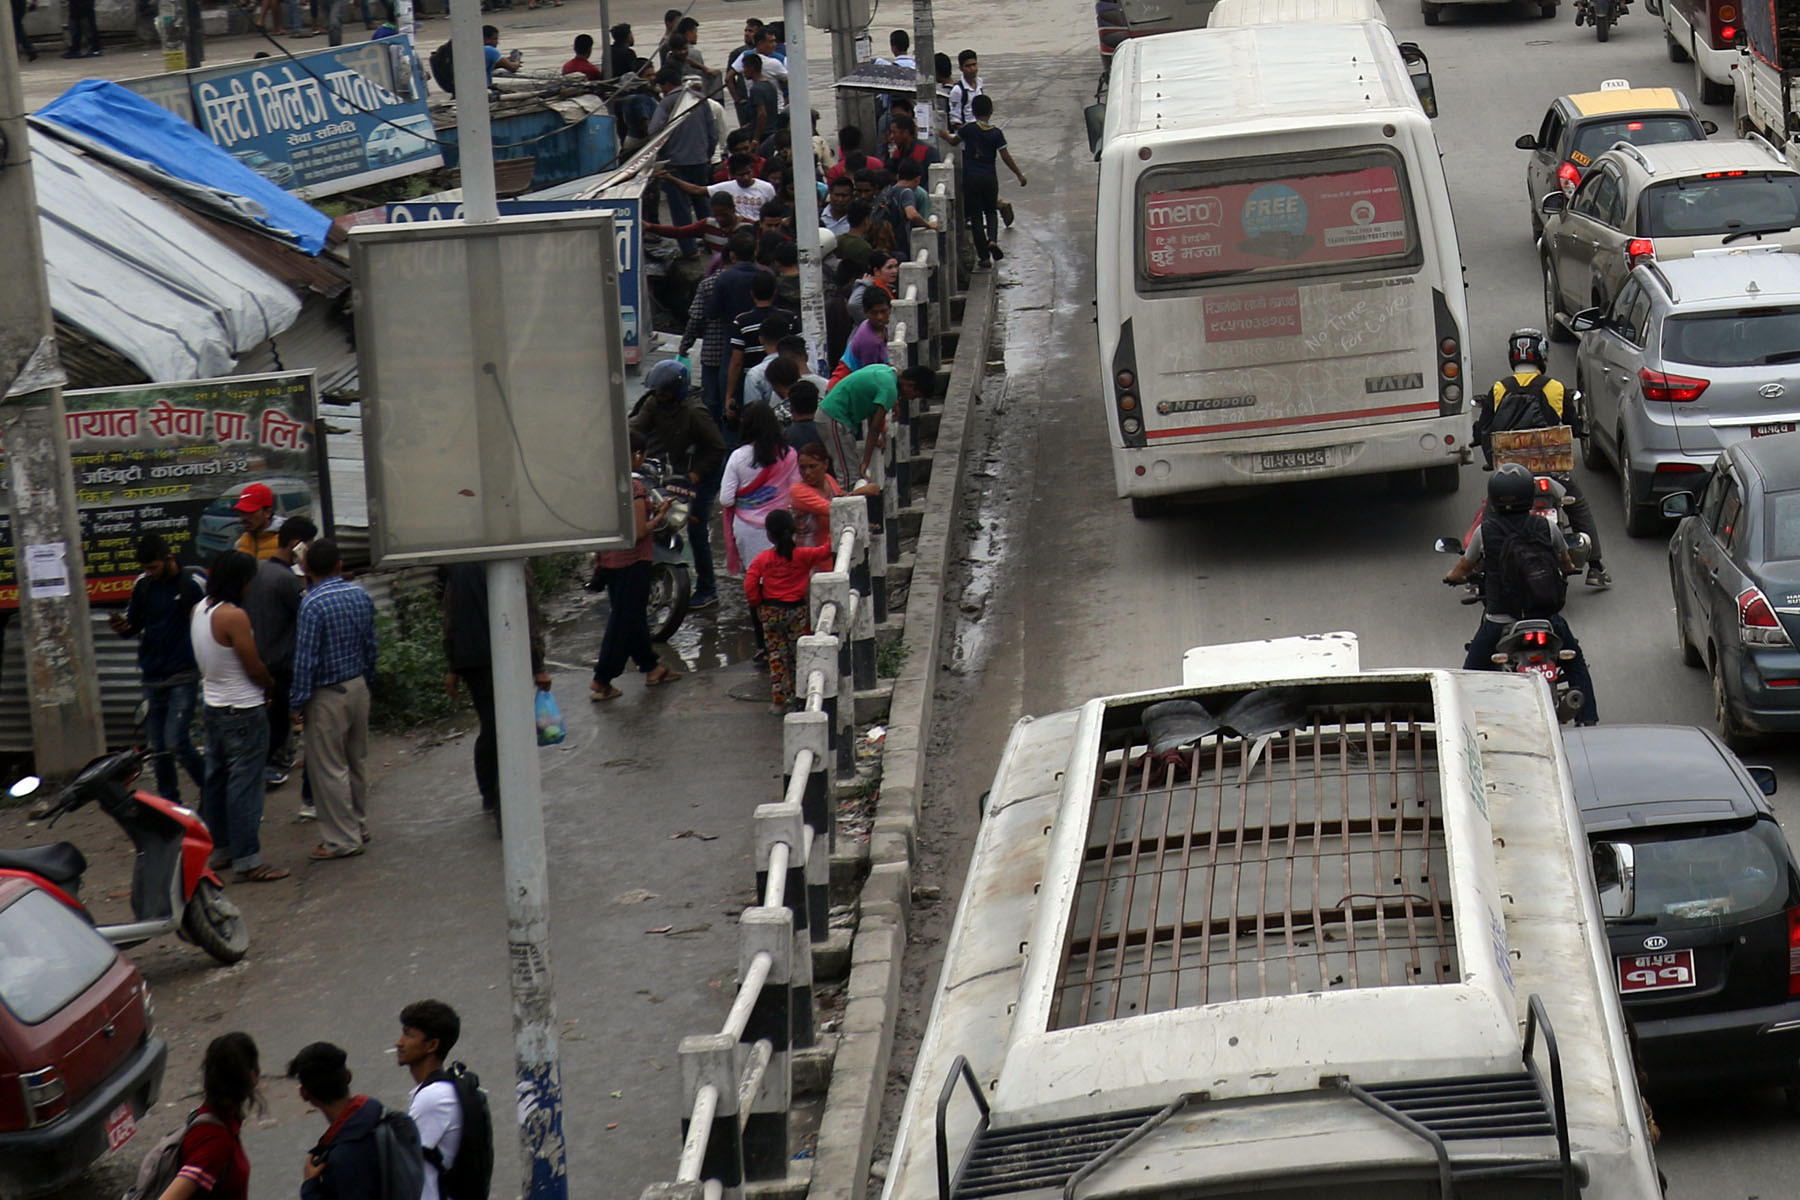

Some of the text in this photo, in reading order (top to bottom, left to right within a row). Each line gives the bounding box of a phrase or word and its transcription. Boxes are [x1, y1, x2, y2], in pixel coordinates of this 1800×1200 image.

[199, 78, 258, 147] सिटी
[287, 121, 357, 146] सेवा समिति
[1572, 151, 1591, 167] TAXI
[1148, 205, 1211, 226] mero
[1245, 196, 1299, 218] FREE
[1367, 374, 1421, 391] TATA
[1174, 395, 1256, 411] Marcopolo
[149, 400, 205, 437] सेवा
[214, 411, 251, 443] प्रा.
[261, 409, 306, 450] लि.
[1647, 939, 1665, 947] KIA
